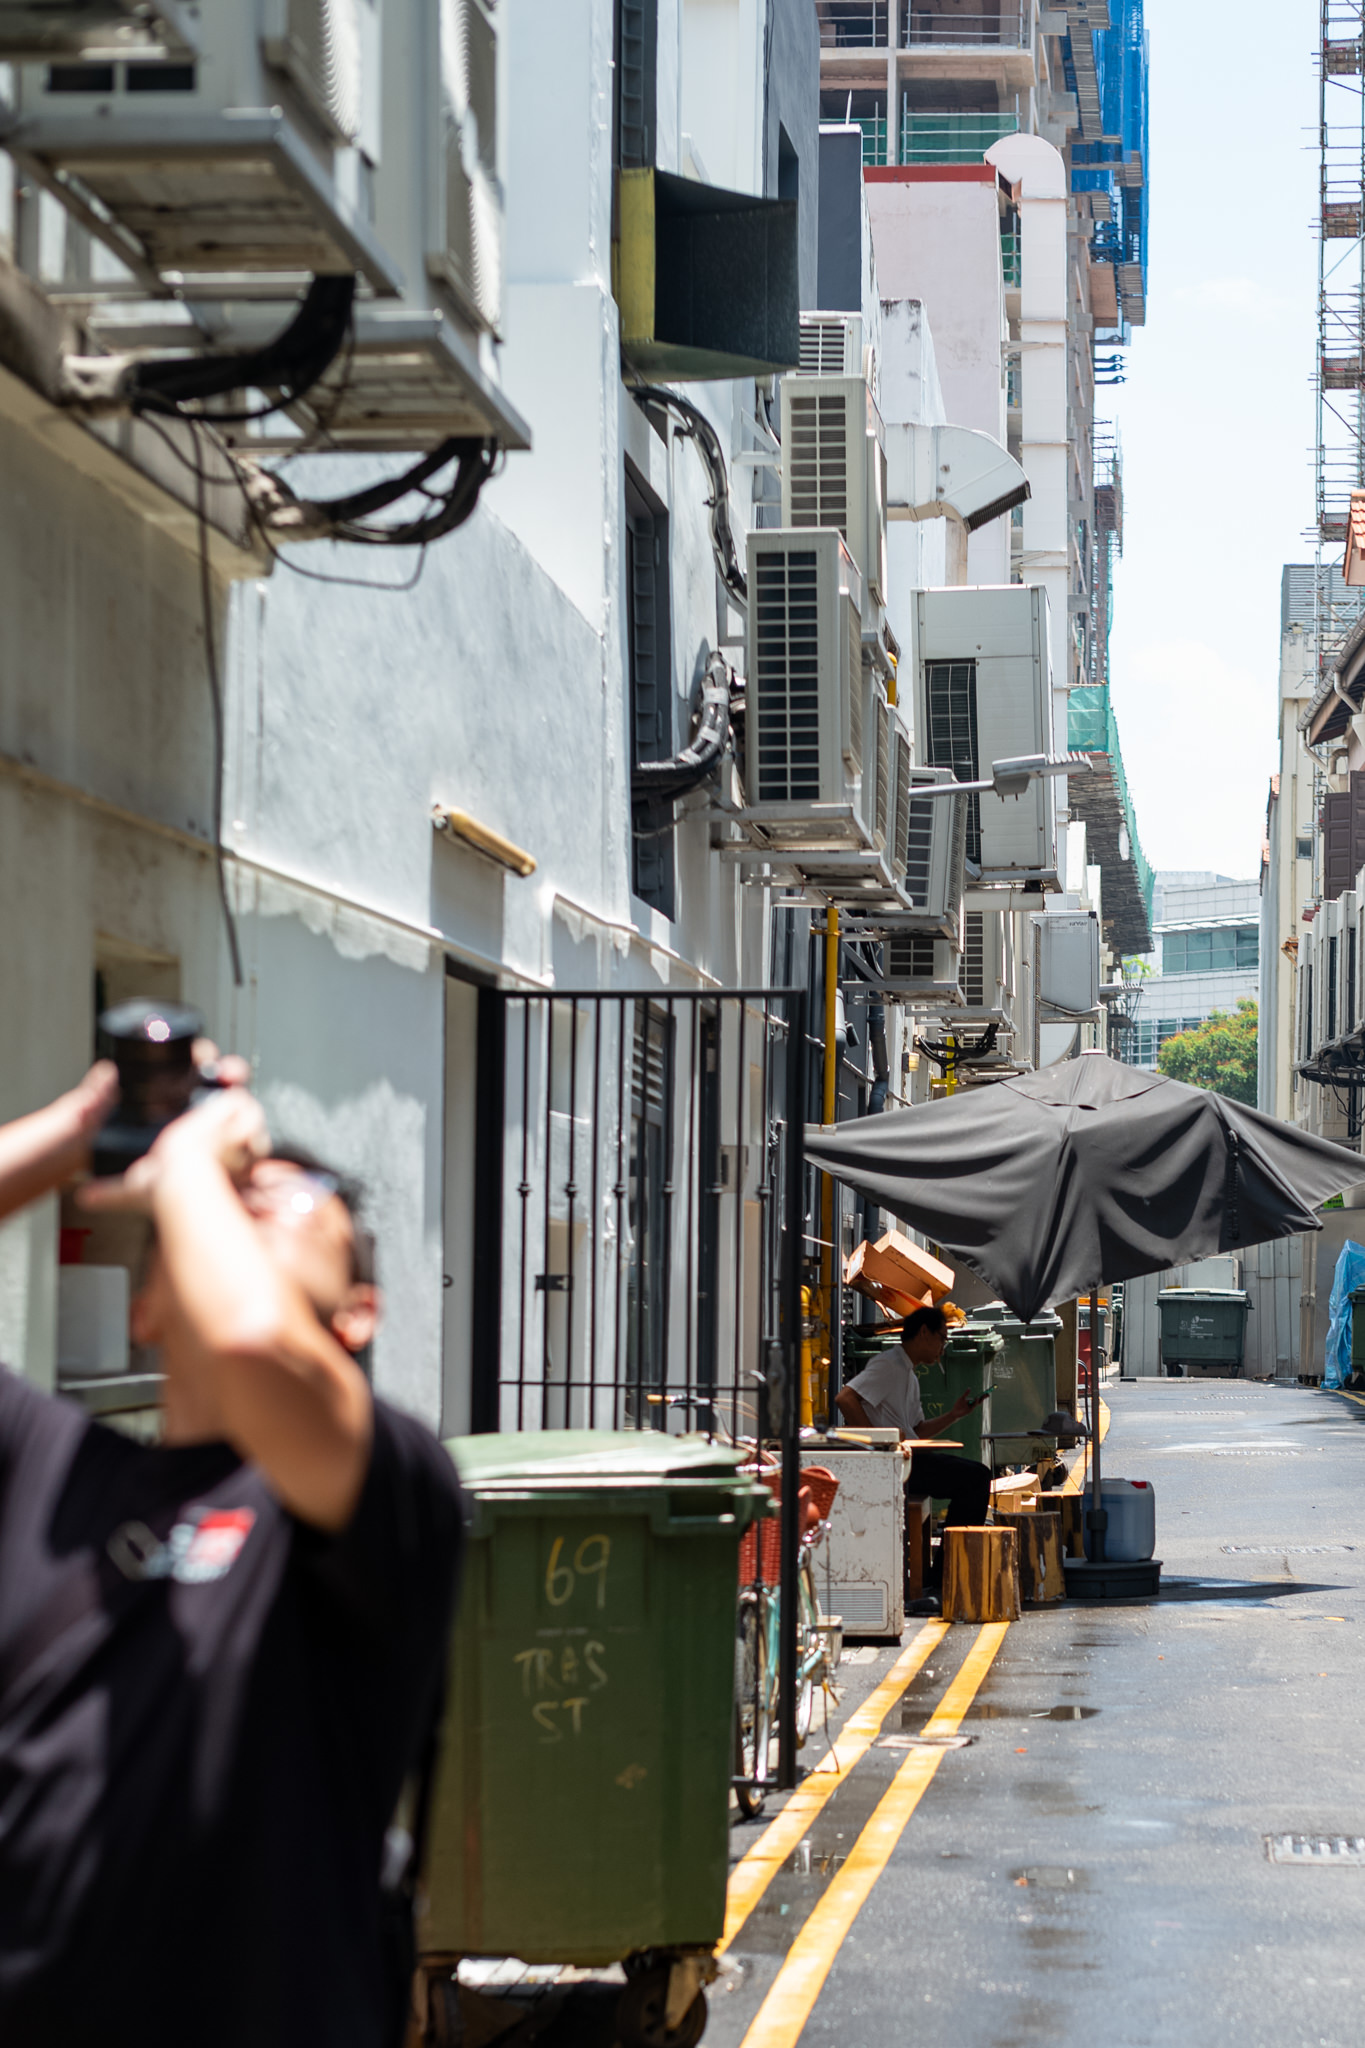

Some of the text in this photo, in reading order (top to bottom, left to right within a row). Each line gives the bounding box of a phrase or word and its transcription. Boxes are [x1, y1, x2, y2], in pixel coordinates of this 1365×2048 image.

[545, 1533, 611, 1610] 69
[513, 1640, 608, 1697] TRAS
[532, 1697, 589, 1744] ST
